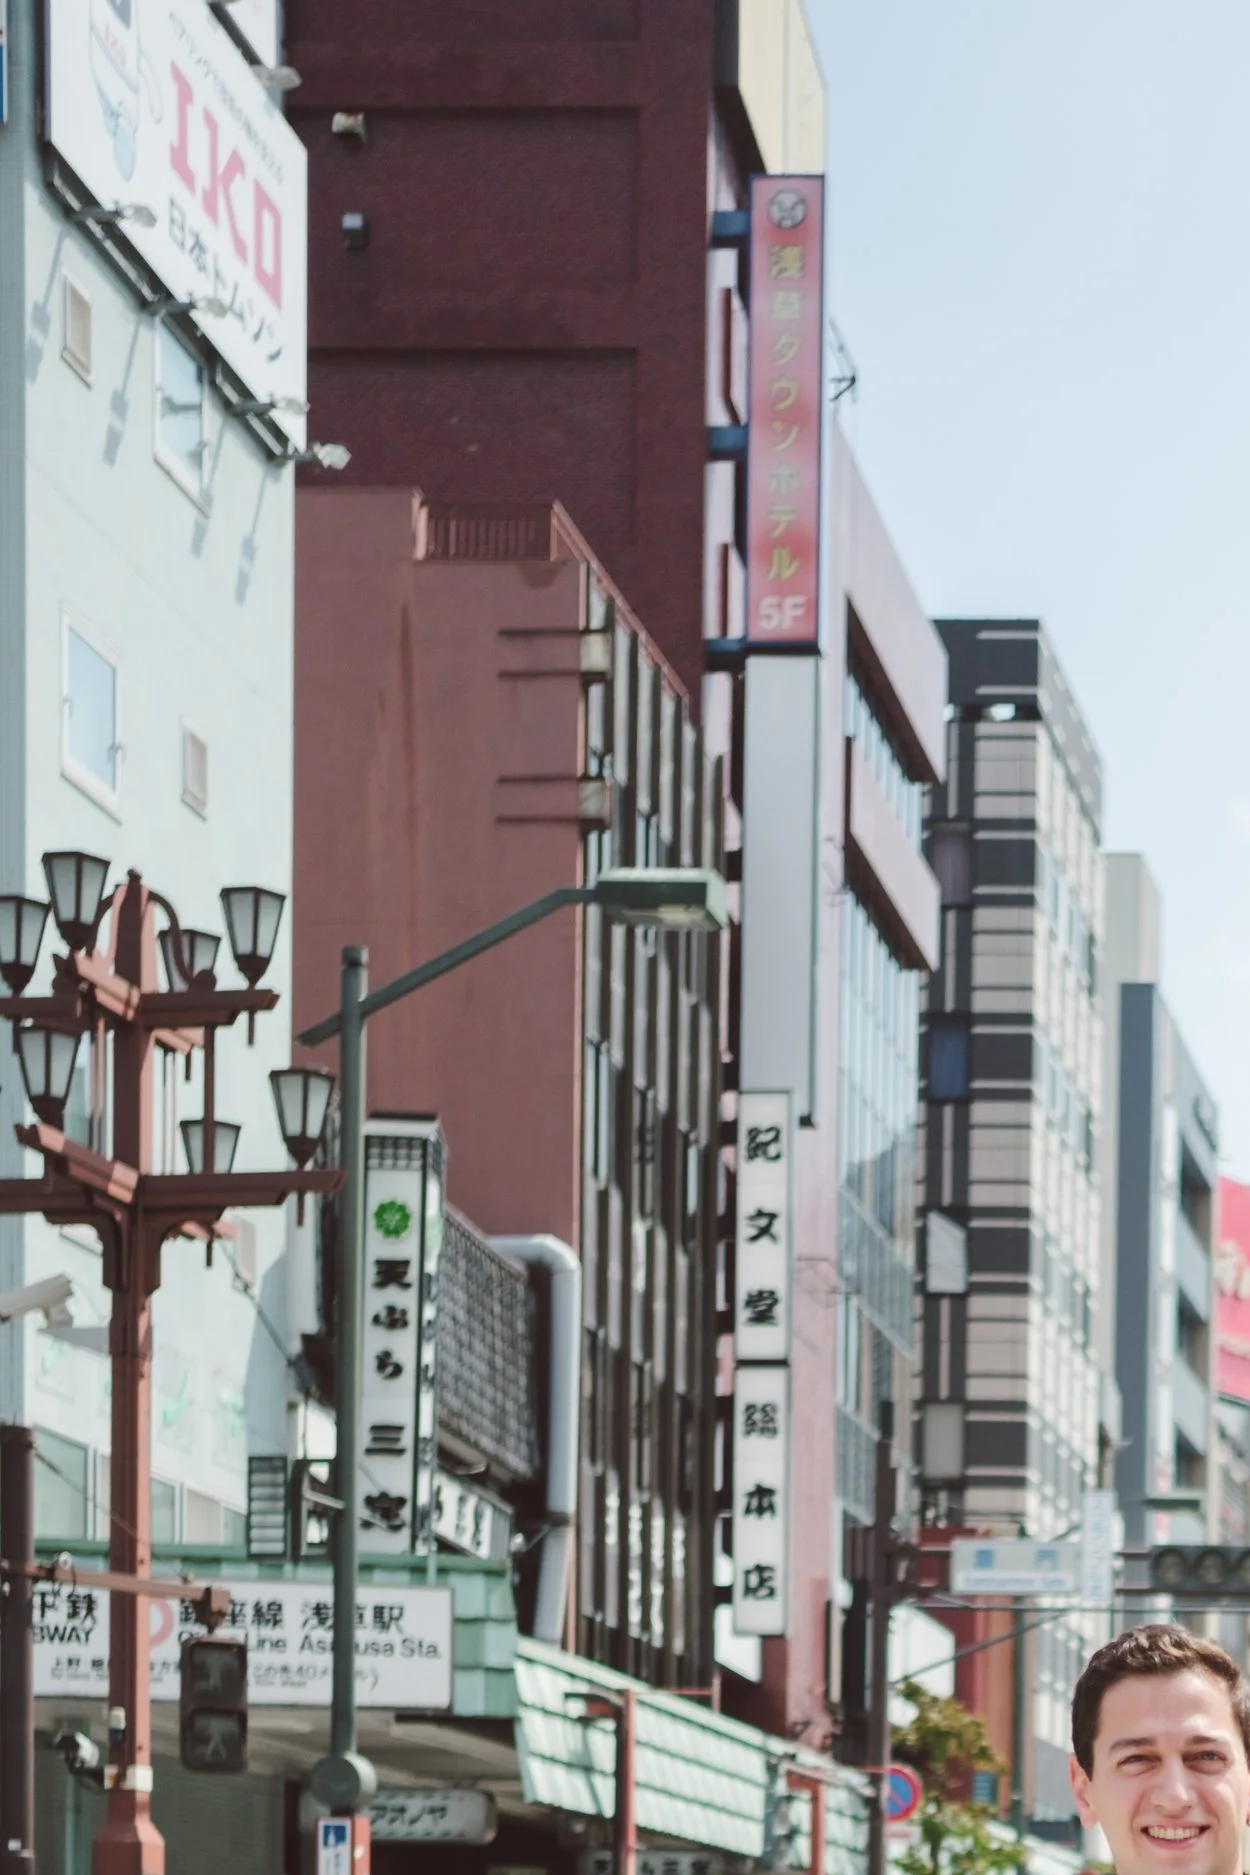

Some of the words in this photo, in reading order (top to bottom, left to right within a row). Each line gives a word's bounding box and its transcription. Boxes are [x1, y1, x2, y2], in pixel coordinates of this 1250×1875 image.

[170, 60, 282, 311] IKO
[168, 196, 283, 362] 日本トムソン
[767, 243, 806, 582] 浅草タウンホテル
[758, 595, 807, 630] 5F
[33, 1592, 97, 1625] 下鉄
[34, 1624, 95, 1645] BWAY
[299, 1635, 396, 1660] Asausa
[401, 1638, 442, 1661] Sta.
